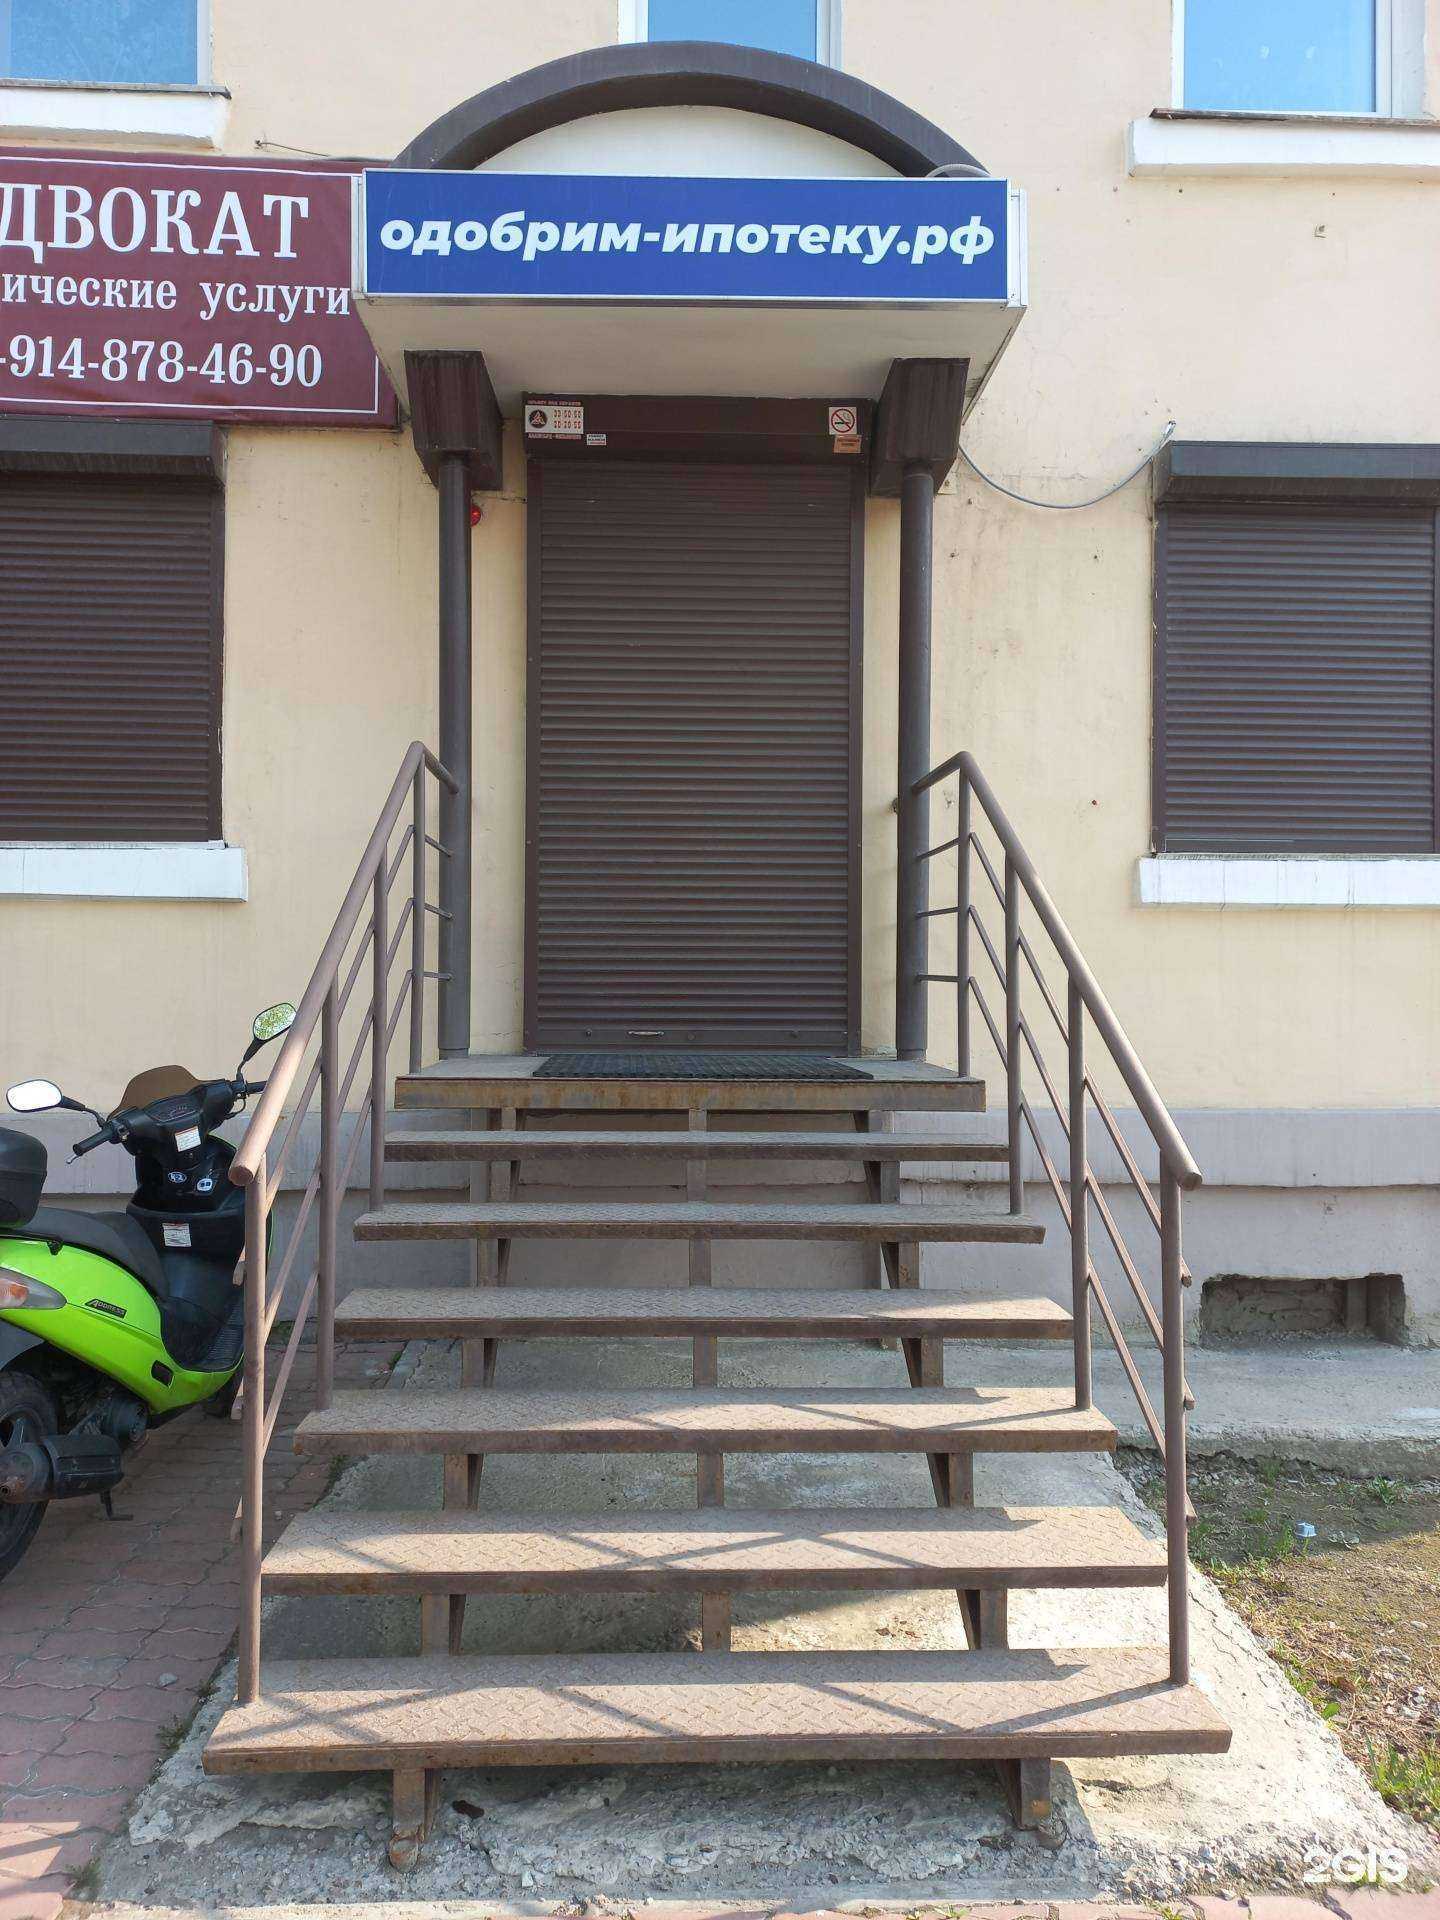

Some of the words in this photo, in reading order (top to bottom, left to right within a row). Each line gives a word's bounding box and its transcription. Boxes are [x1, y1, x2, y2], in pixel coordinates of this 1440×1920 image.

[0, 183, 309, 264] ДВОКАТ
[379, 210, 995, 264] одобрим-ипотеку.рф
[1, 273, 177, 310] ические
[199, 282, 350, 323] услуги
